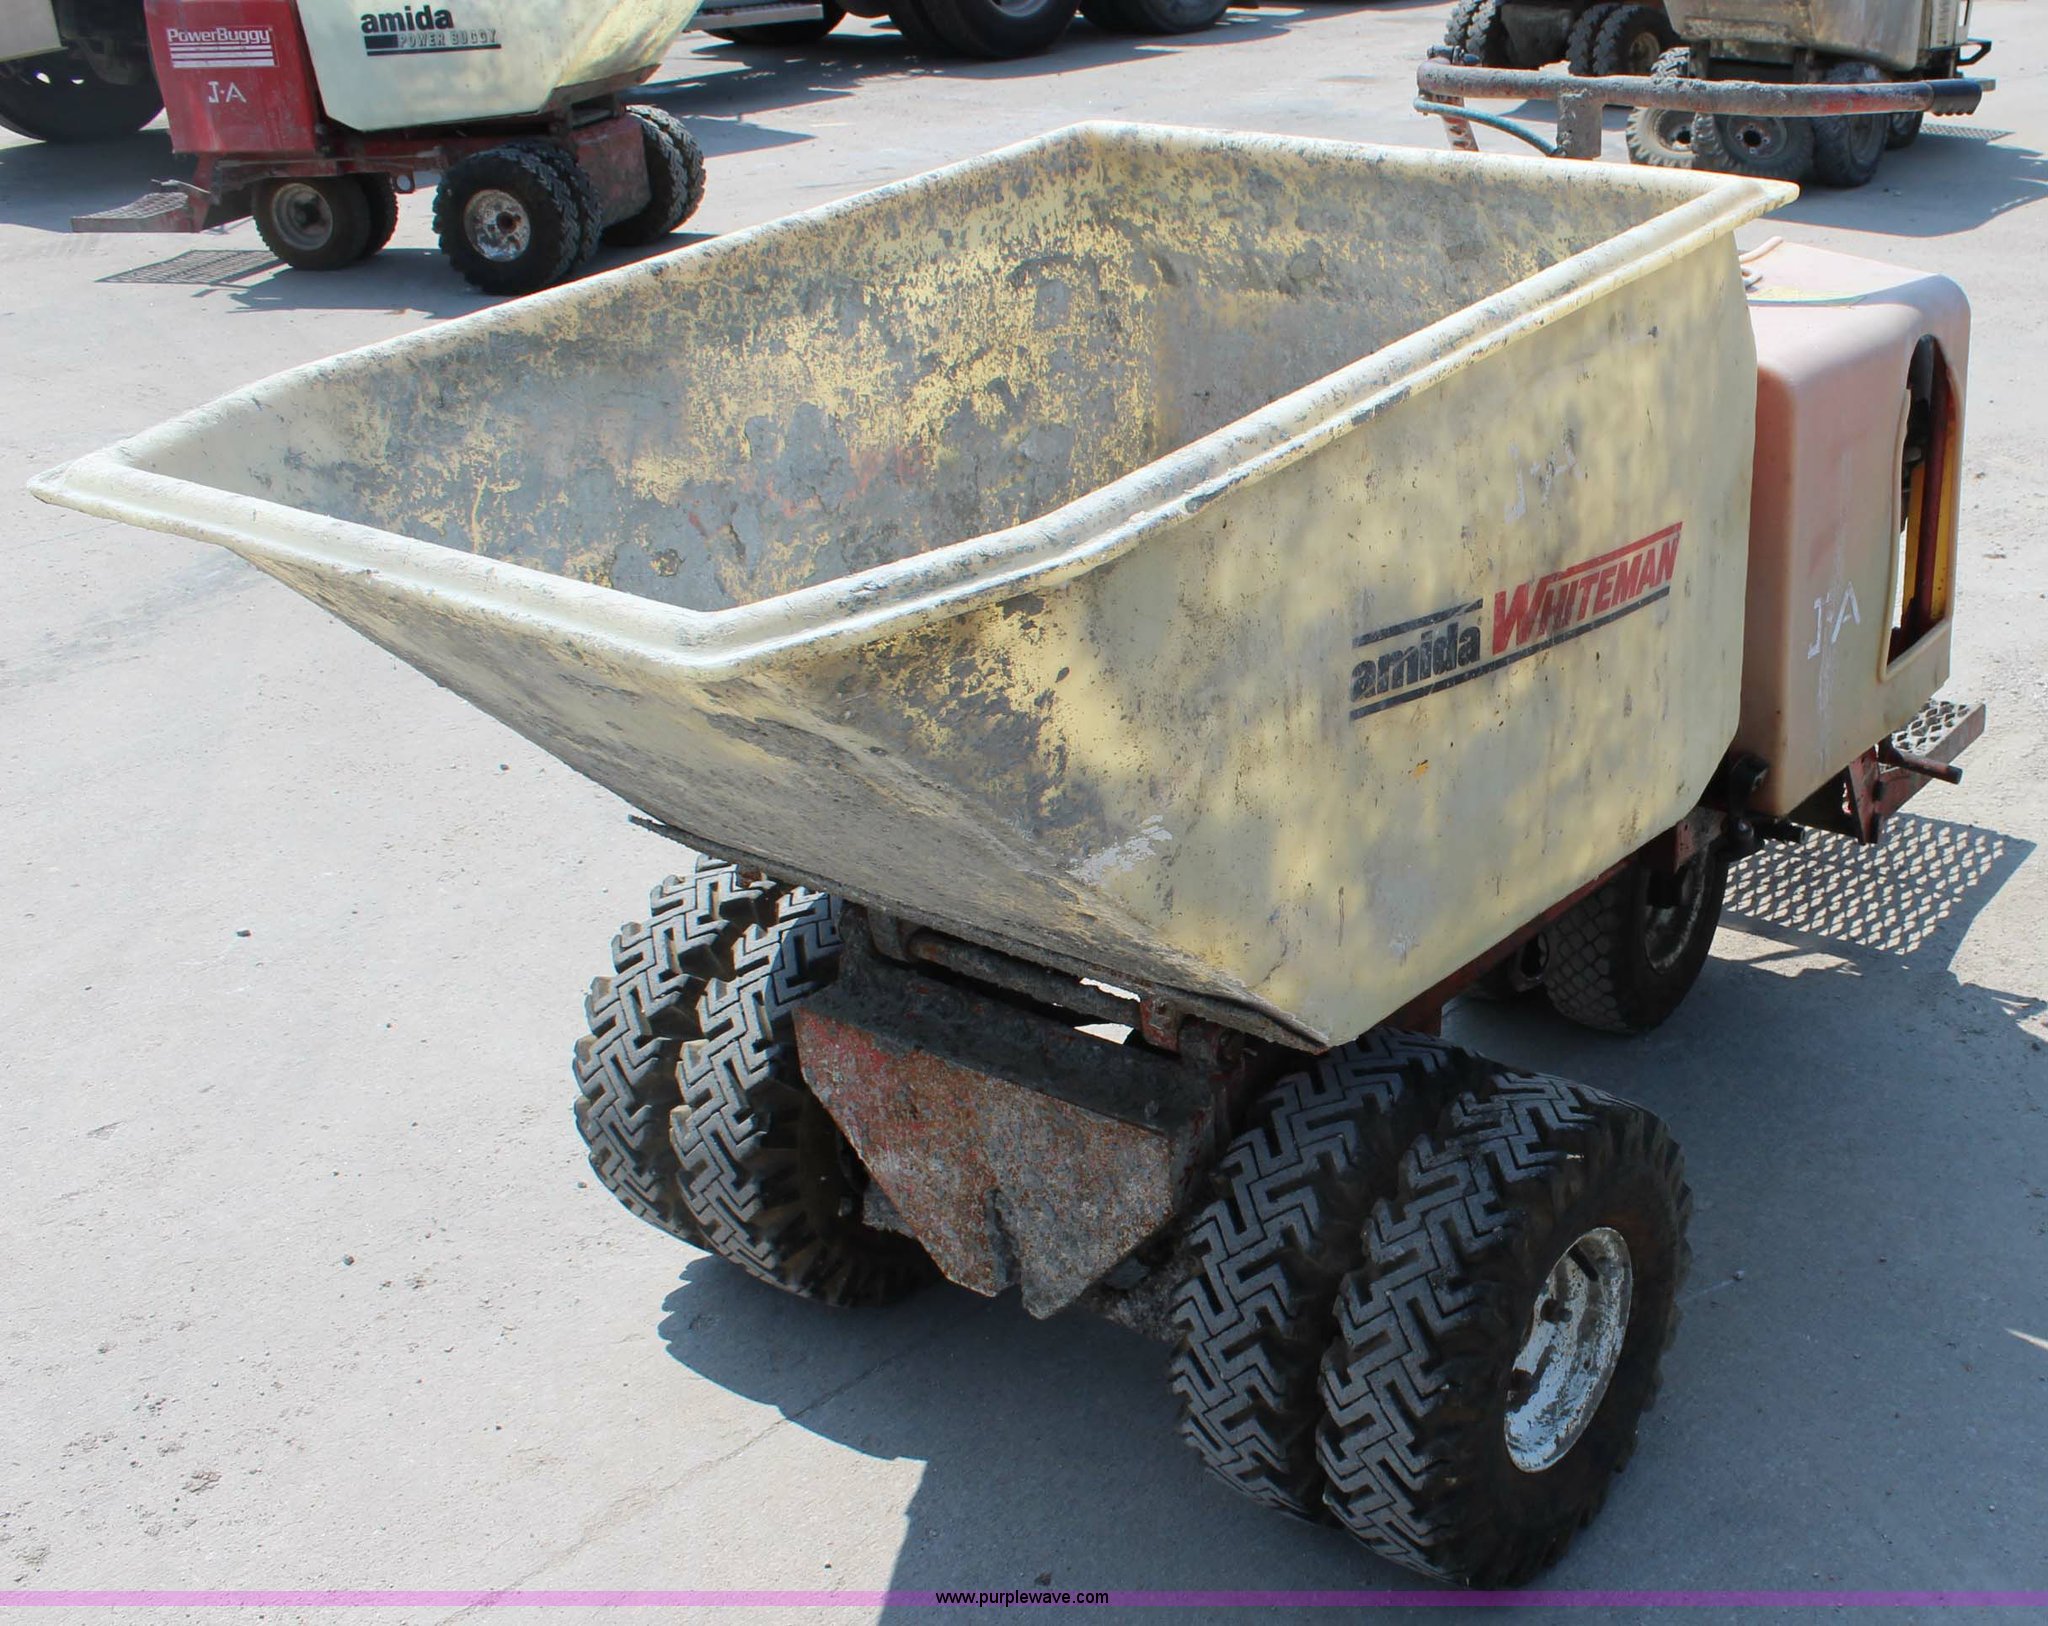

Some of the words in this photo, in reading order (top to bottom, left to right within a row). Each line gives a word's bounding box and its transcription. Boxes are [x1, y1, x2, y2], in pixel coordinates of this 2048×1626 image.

[360, 5, 454, 34] amida
[166, 27, 271, 44] PowerBuggy
[399, 33, 446, 48] POWER
[451, 29, 496, 45] BUGGY
[1351, 621, 1481, 702] amida
[1493, 535, 1682, 656] WHITEMAN
